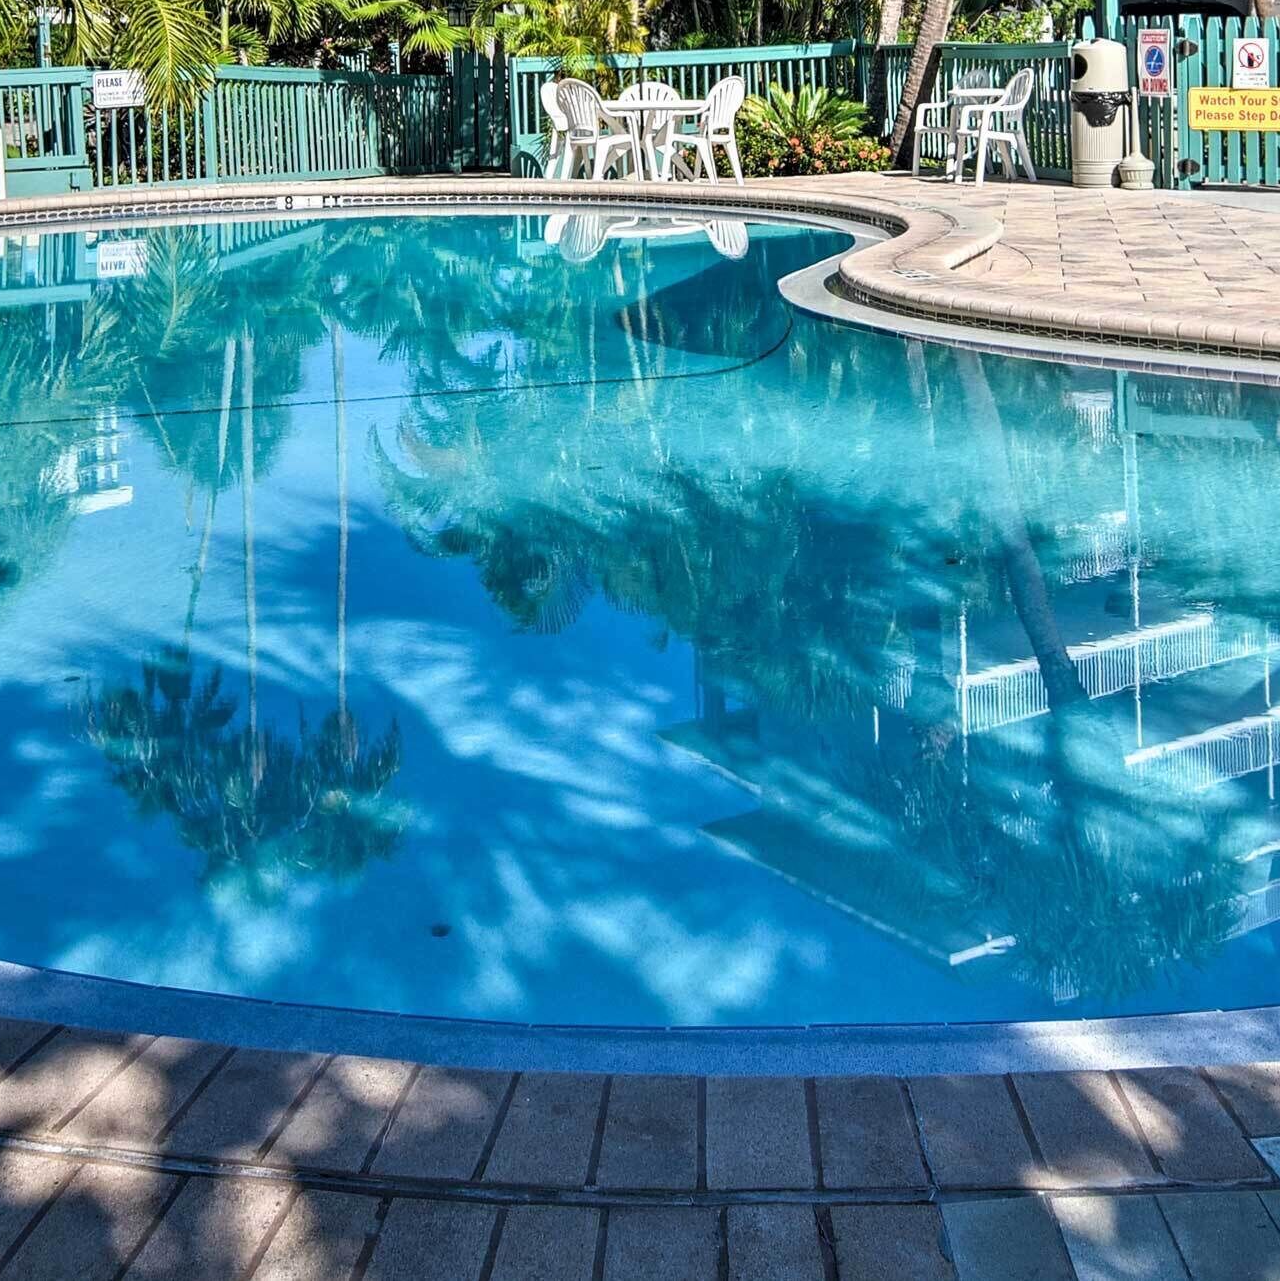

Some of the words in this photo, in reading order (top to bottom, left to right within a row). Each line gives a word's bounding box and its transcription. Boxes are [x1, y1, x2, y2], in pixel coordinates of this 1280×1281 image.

[97, 78, 122, 88] PLEASE
[1199, 94, 1236, 106] Watch
[1240, 94, 1267, 106] Your
[1195, 109, 1234, 120] Please
[1239, 110, 1266, 123] Step
[285, 196, 293, 210] 8
